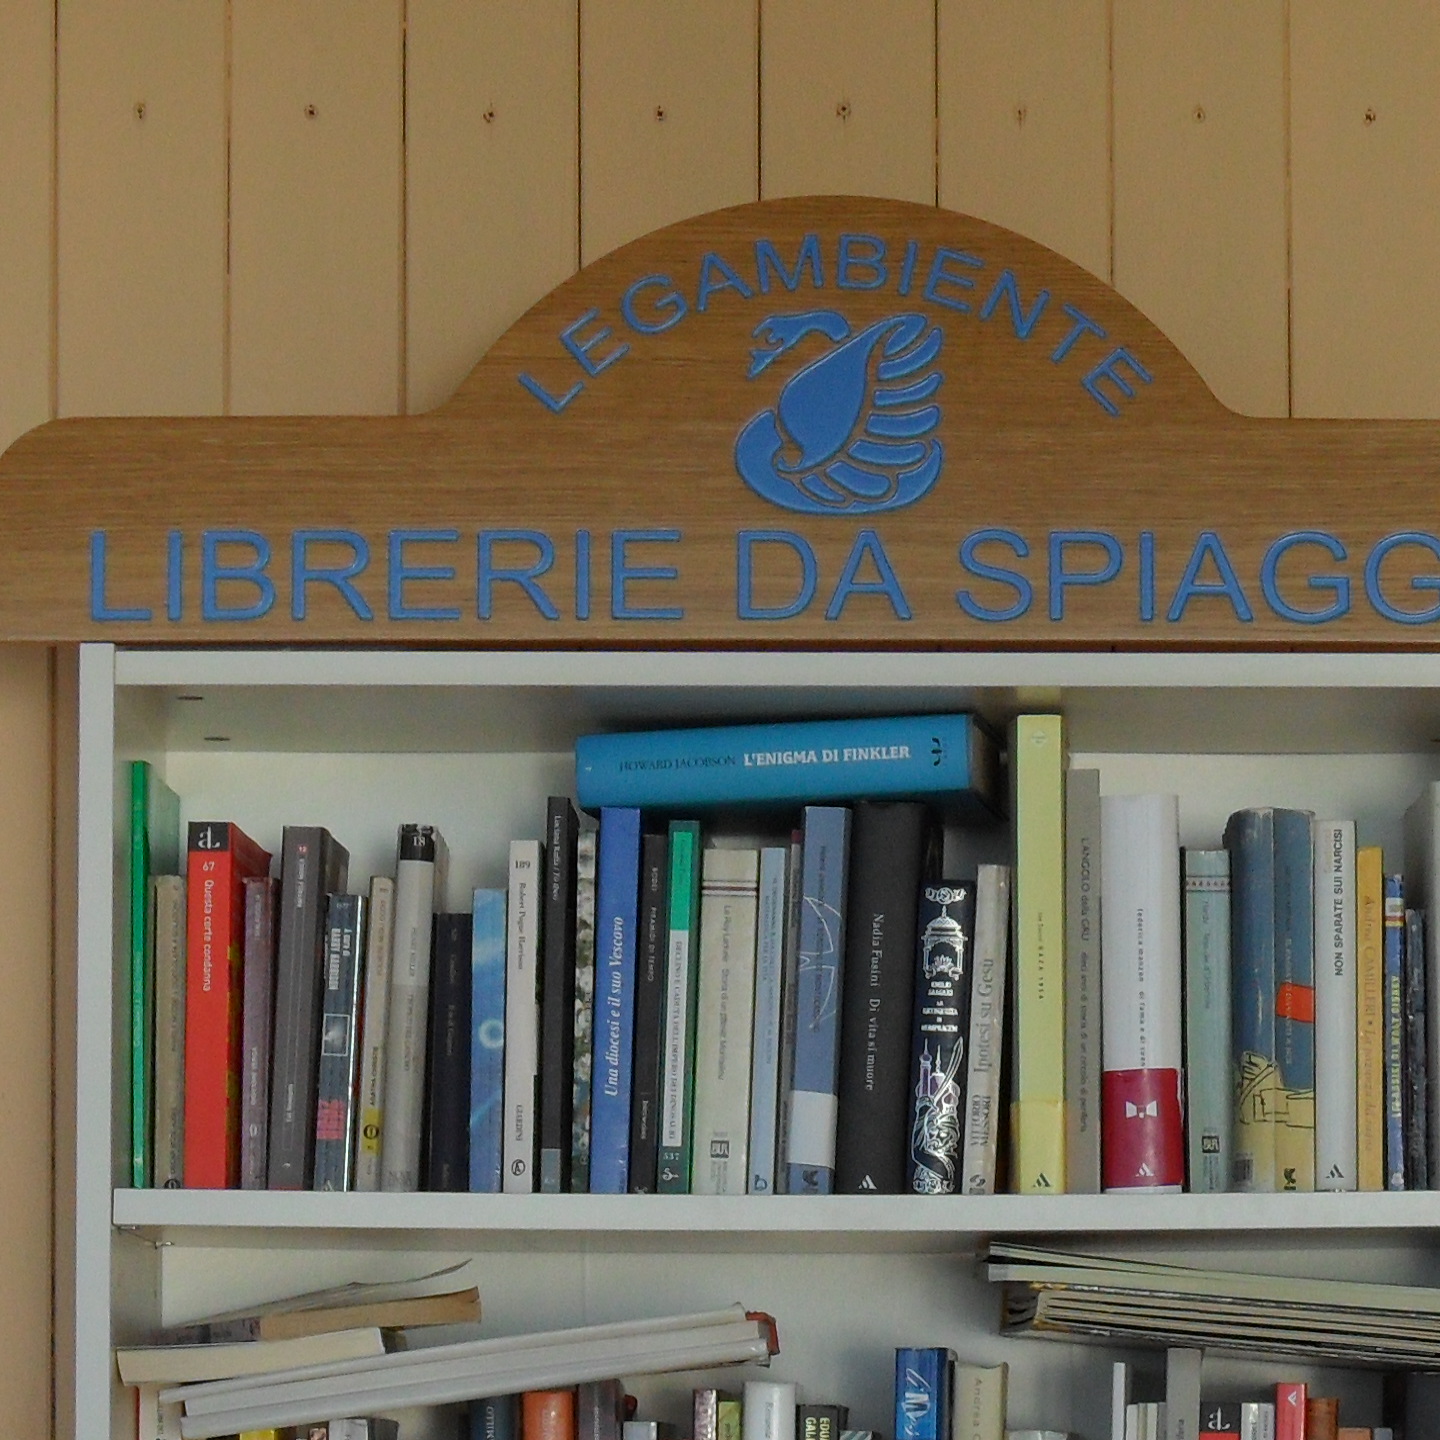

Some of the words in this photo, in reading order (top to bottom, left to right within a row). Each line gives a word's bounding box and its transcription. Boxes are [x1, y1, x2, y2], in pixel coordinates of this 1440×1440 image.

[516, 231, 1156, 421] LEGAMBIENTE
[87, 527, 685, 624] LIBRERIE
[735, 527, 913, 623] DA
[619, 759, 672, 772] HOWARD
[743, 750, 817, 767] L'ENIGMA
[822, 748, 839, 762] DI
[843, 746, 910, 762] FINKLER
[1333, 829, 1343, 873] NARCISI
[202, 861, 215, 872] 67
[204, 880, 214, 917] Questa
[1332, 876, 1343, 895] SUI
[203, 919, 212, 942] corte
[1333, 898, 1343, 951] SPARATE
[609, 916, 624, 966] Vescovo
[202, 944, 212, 992] condanna
[1334, 953, 1343, 977] NON
[611, 972, 622, 994] suo
[607, 996, 621, 1007] il
[612, 1009, 621, 1019] e
[606, 1019, 620, 1065] diocesi
[605, 1069, 618, 1097] Una
